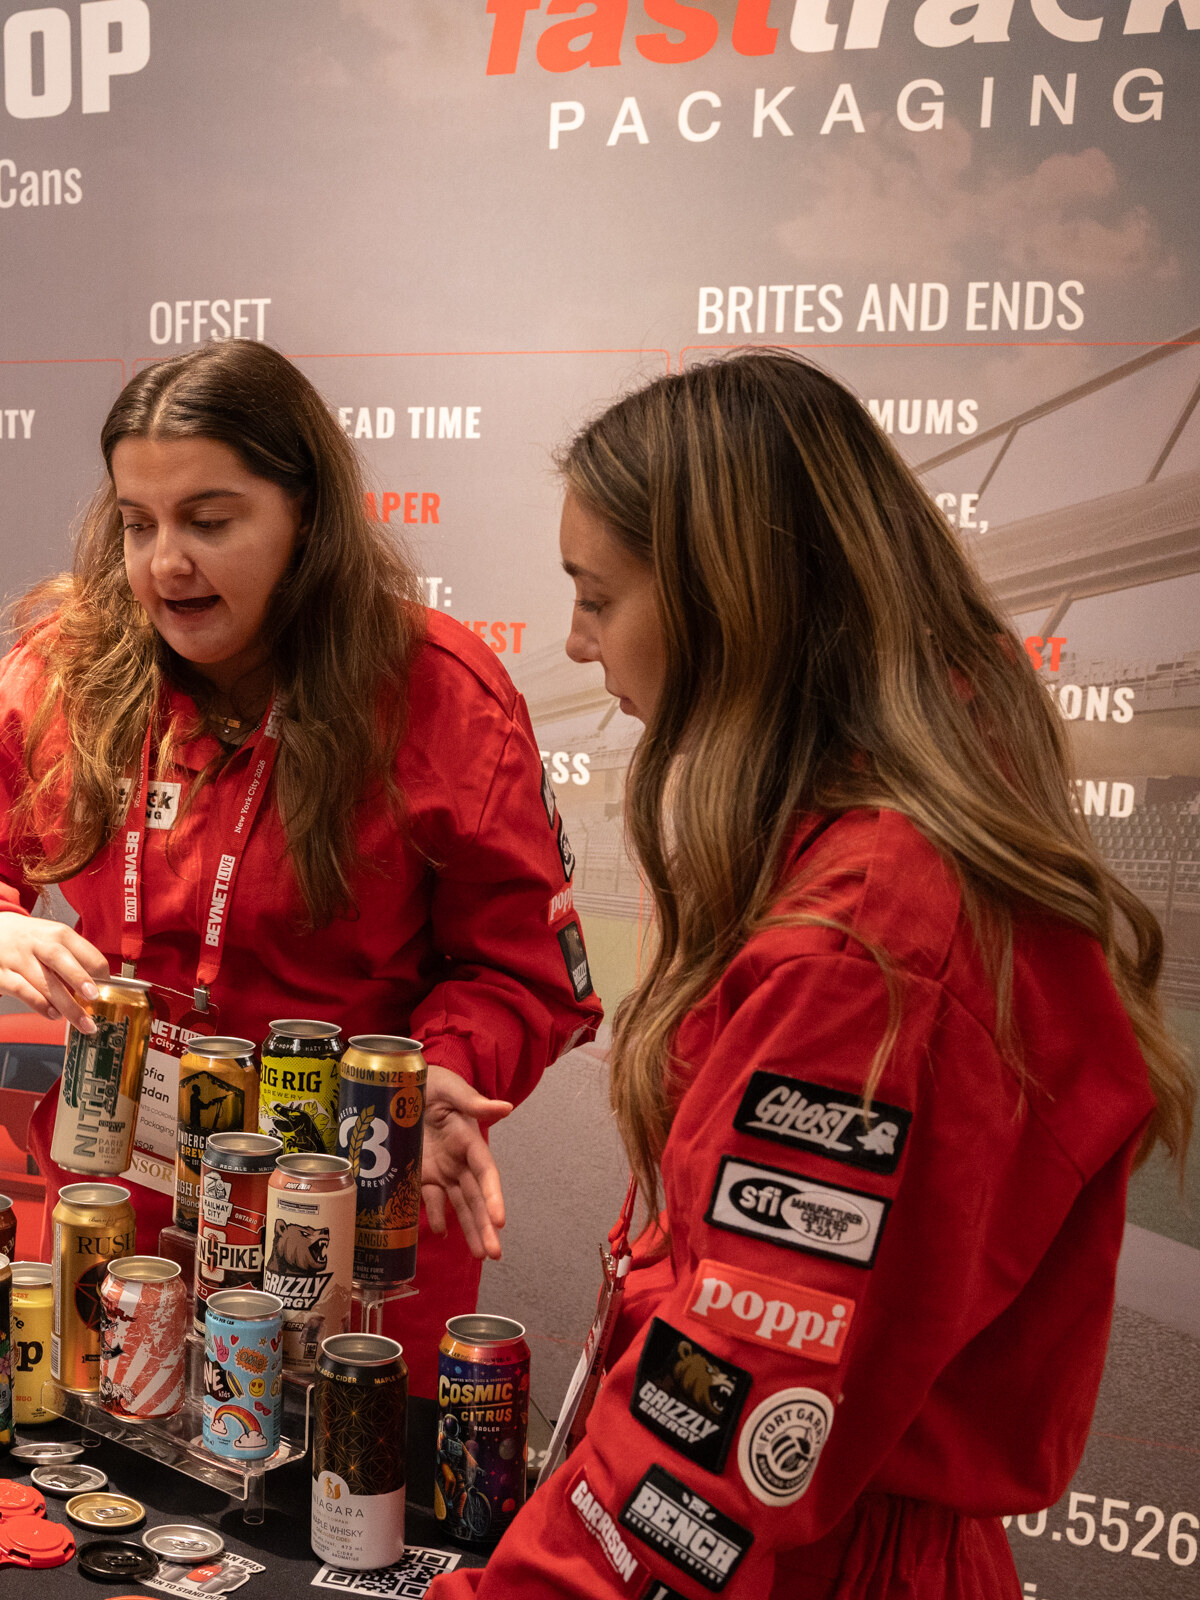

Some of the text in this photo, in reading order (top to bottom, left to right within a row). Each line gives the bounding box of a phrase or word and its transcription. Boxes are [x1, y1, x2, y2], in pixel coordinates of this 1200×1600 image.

[549, 67, 1164, 149] PACKAGING
[698, 280, 1085, 334] BRITES AND ENDS
[149, 298, 271, 345] OFFSET
[338, 406, 481, 439] EAD TIME
[864, 399, 979, 435] MUMS
[365, 491, 441, 524] APER
[234, 759, 267, 834] New York City 2026
[123, 831, 141, 923] BEVNET.LIVE
[205, 853, 237, 947] BEVNET.LIVE
[155, 1037, 176, 1051] City
[144, 1067, 165, 1082] ofia
[282, 1070, 322, 1093] RIG
[379, 1071, 404, 1083] SIZE
[140, 1086, 170, 1104] adan
[263, 1088, 303, 1100] BREWERY
[746, 1085, 880, 1152] GHOST
[134, 1139, 154, 1153] NSOR
[131, 1155, 173, 1183] NSOR
[360, 1167, 398, 1187] BREWING
[204, 1199, 230, 1213] RAILWAY
[207, 1208, 221, 1219] CITY
[739, 1185, 782, 1217] sfi
[790, 1197, 863, 1226] MANUFACTURER
[234, 1213, 258, 1225] ONTARIO
[800, 1210, 849, 1233] CERTIFIED
[357, 1232, 389, 1248] ANGUS
[207, 1239, 260, 1270] SPIKE
[264, 1270, 329, 1298] GRIZZLY
[691, 1277, 847, 1349] poppi
[320, 1368, 335, 1379] AGED
[335, 1374, 358, 1384] CIDER
[218, 1390, 231, 1399] kids
[461, 1407, 513, 1423] CITRUS
[638, 1380, 721, 1440] GRIZZLY
[638, 1402, 701, 1445] ENERGY
[759, 1409, 793, 1443] FORT
[329, 1525, 363, 1538] WHISKY
[570, 1480, 639, 1584] GARRISON
[630, 1485, 740, 1575] BENCH
[1002, 1491, 1200, 1567] 0.5526
[624, 1511, 671, 1549] BREWING
[674, 1547, 724, 1585] COMPANY
[240, 1558, 263, 1572] WAS
[164, 1582, 177, 1590] TO
[176, 1585, 205, 1599] STAND
